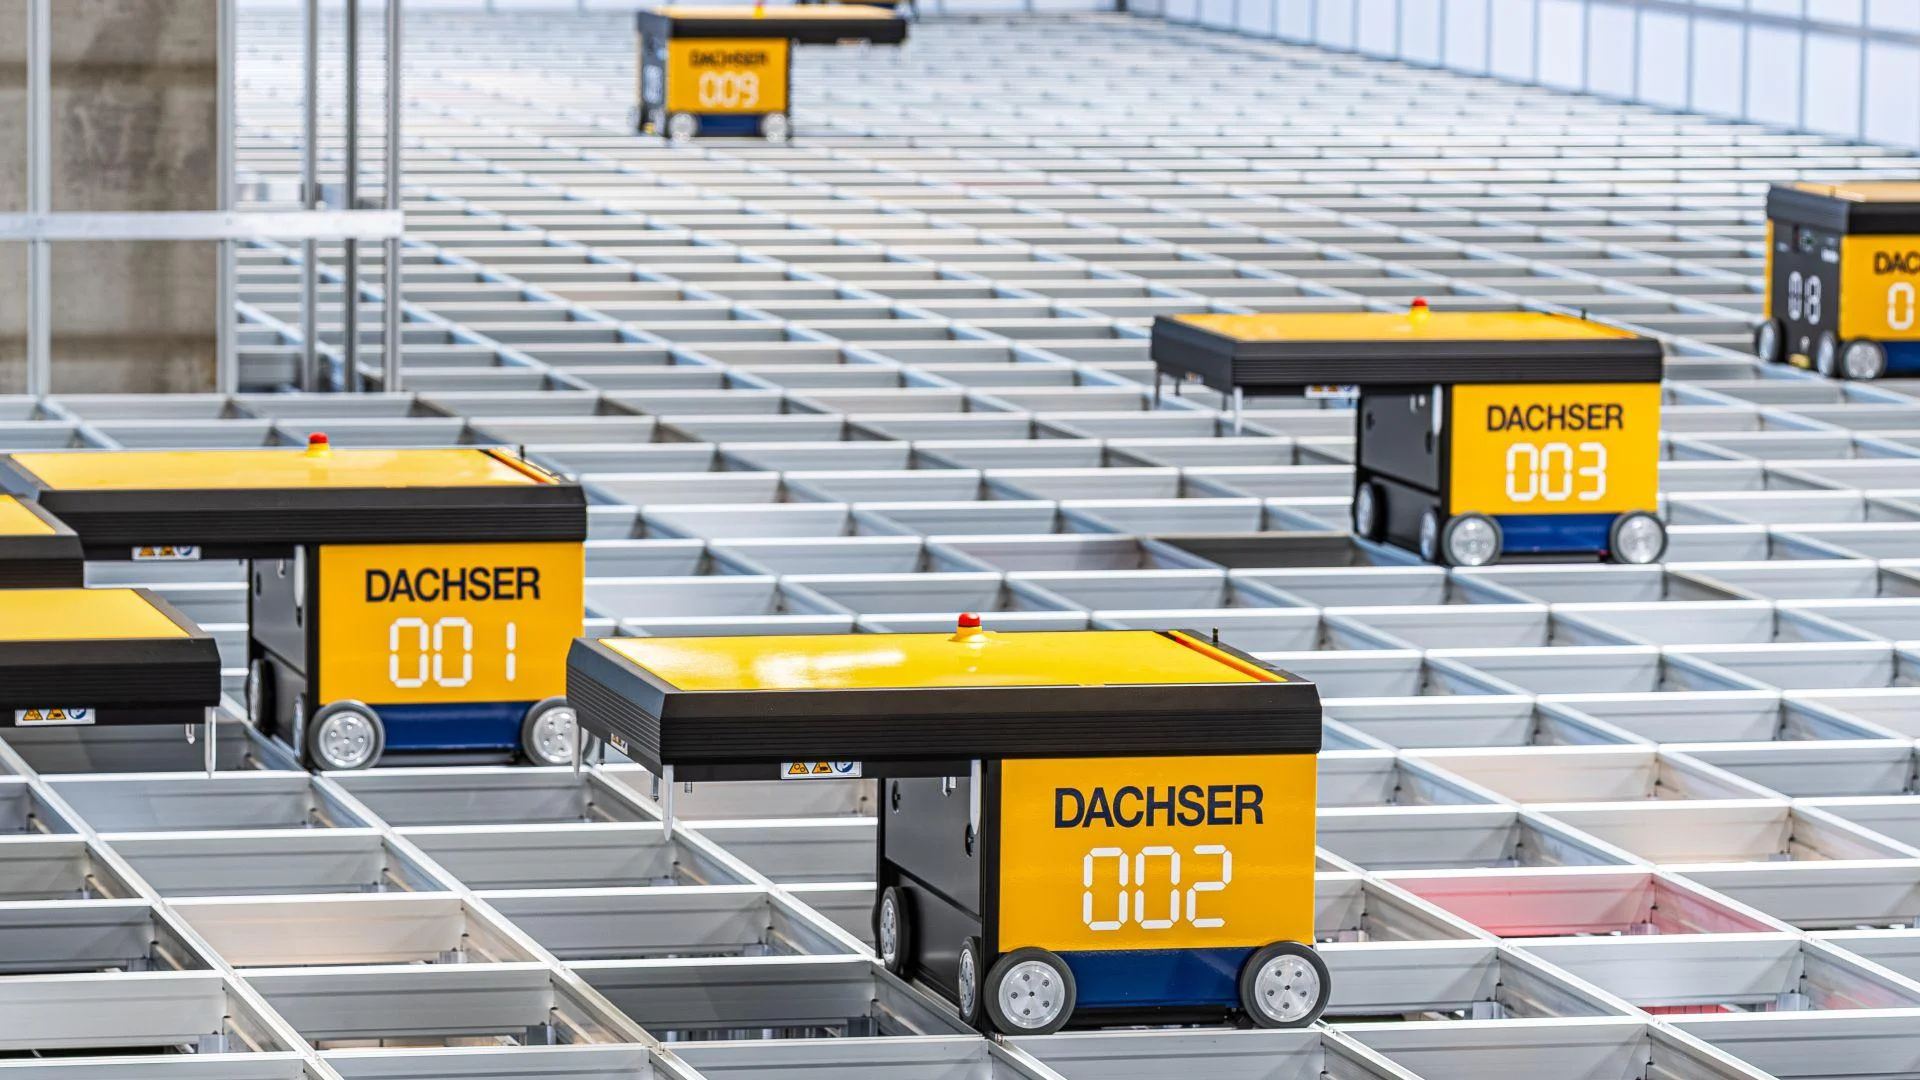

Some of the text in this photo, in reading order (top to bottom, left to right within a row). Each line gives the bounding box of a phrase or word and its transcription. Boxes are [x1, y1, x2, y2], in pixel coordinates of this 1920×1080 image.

[699, 71, 759, 108] 009
[1887, 281, 1915, 330] 0
[1487, 404, 1623, 431] DACHSER
[1505, 442, 1607, 502] 003
[365, 567, 540, 602] DACHSER
[389, 617, 516, 688] 001
[1054, 784, 1263, 828] DACHSER
[1082, 845, 1233, 931] 002
